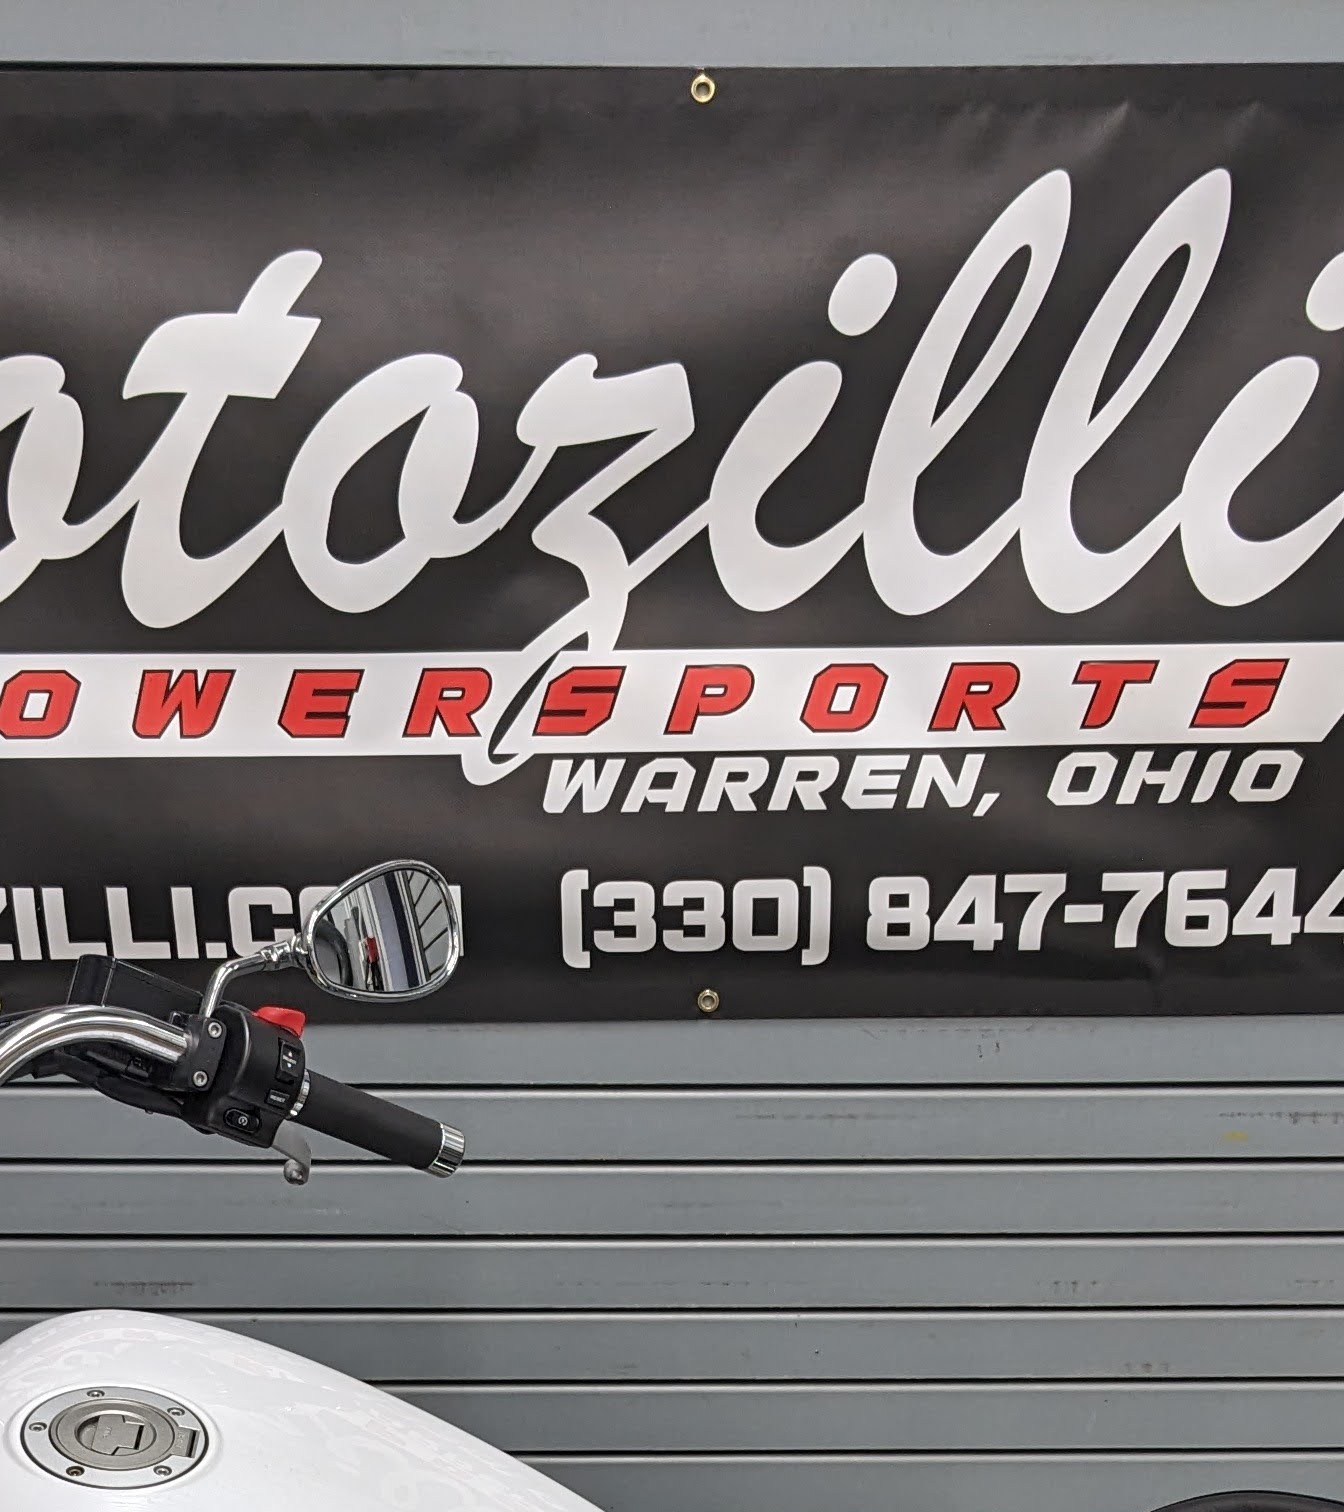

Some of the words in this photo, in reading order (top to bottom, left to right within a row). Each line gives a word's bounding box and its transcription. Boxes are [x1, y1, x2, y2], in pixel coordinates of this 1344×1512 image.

[542, 752, 999, 817] WARREN,
[1046, 749, 1304, 806] OHIO
[560, 865, 832, 968] (330)
